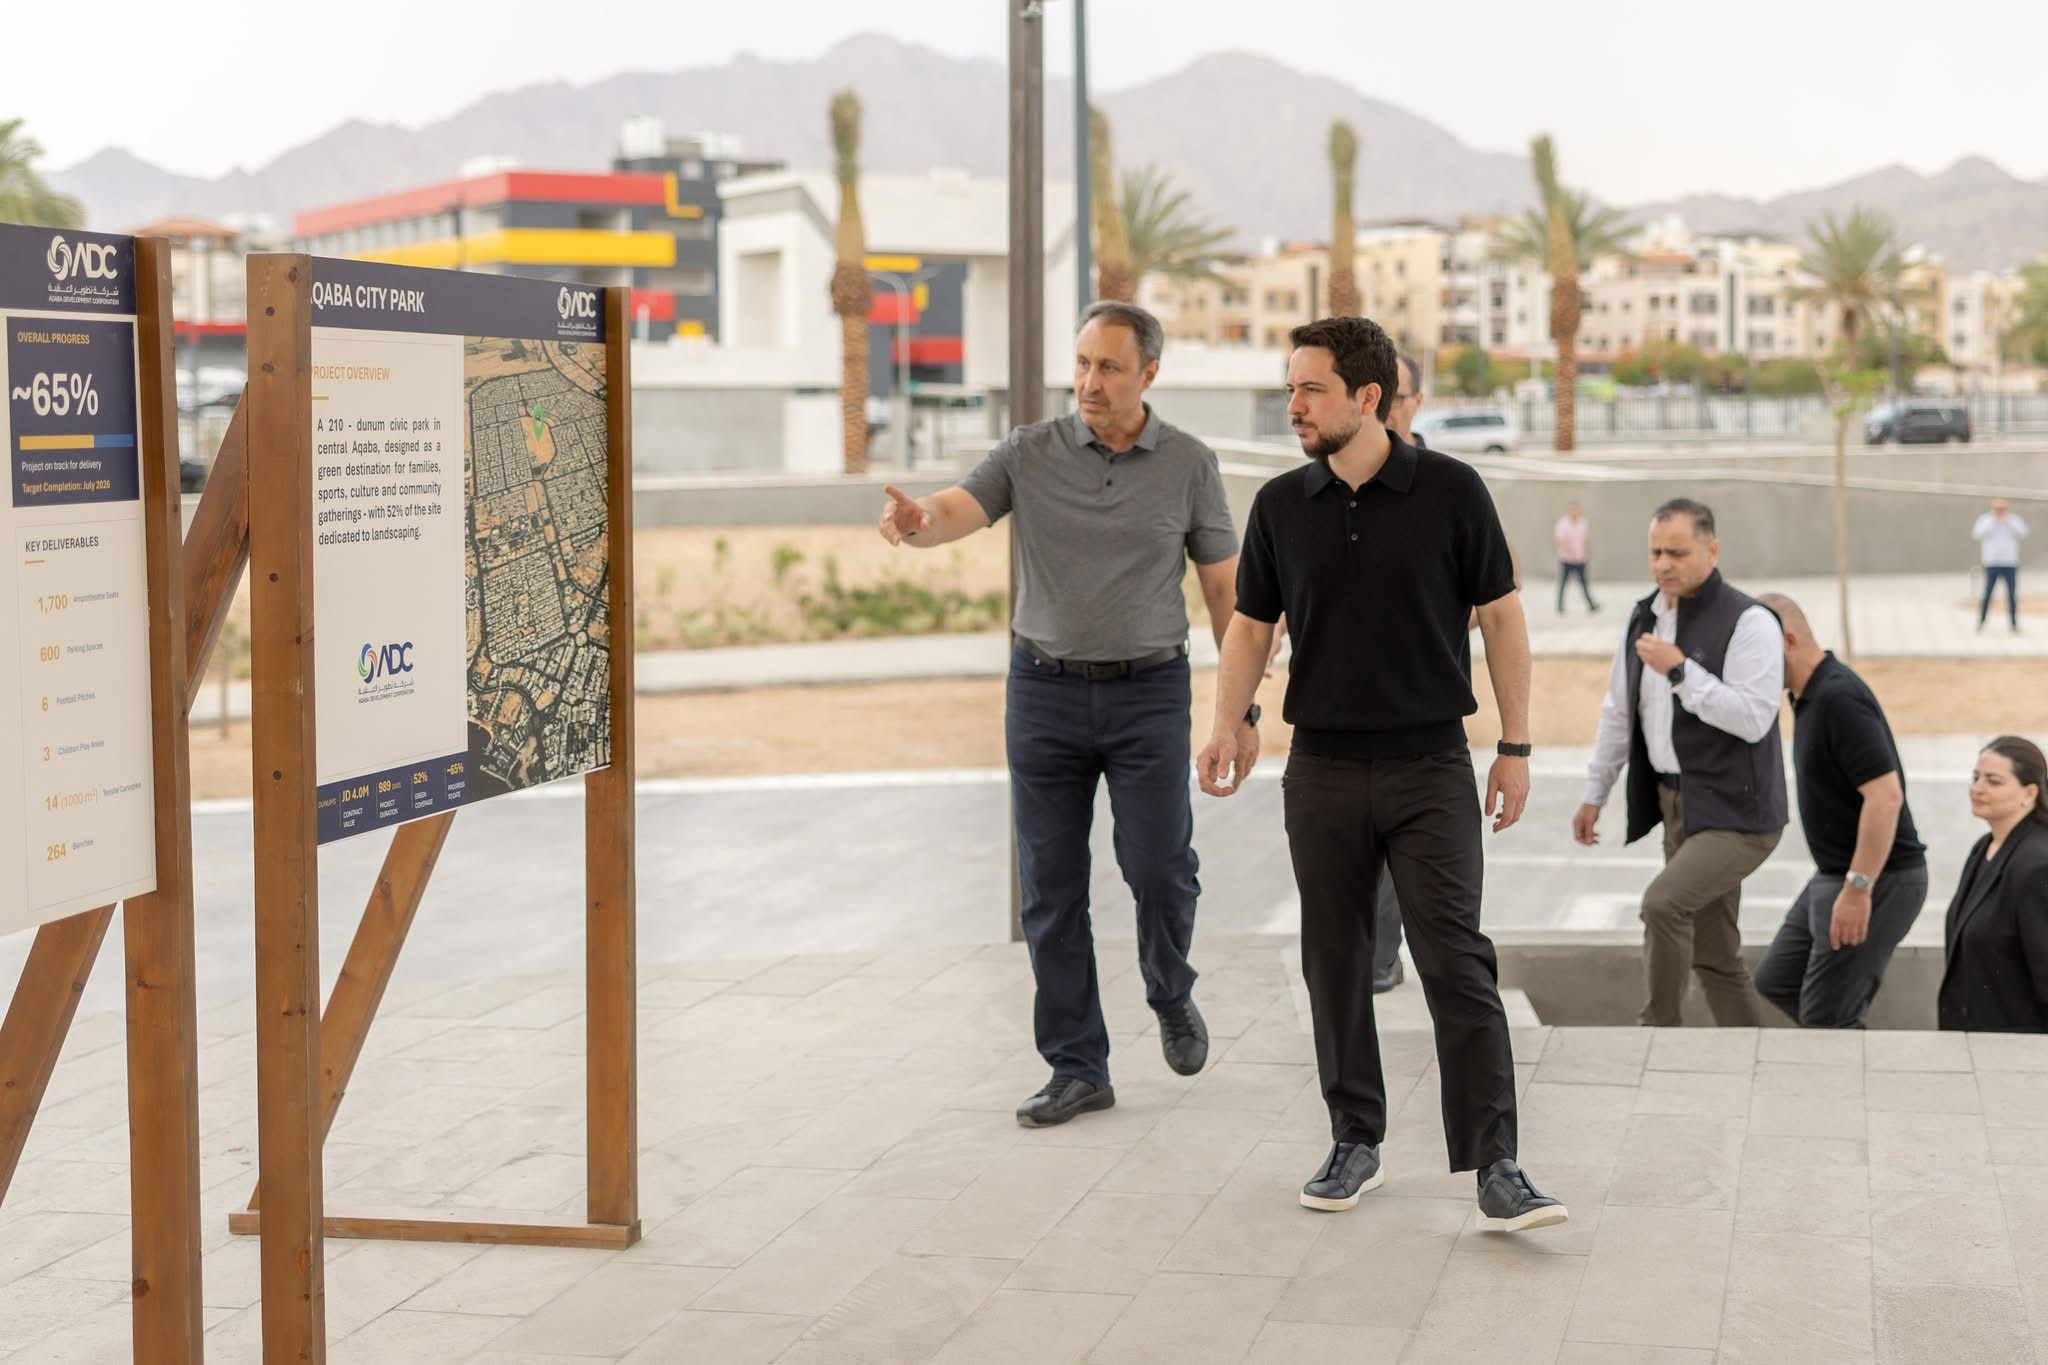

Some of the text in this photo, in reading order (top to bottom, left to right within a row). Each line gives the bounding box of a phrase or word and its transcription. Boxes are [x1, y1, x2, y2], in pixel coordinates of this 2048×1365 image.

[71, 242, 118, 279] ADC
[311, 281, 424, 313] QABA CITY PARK
[570, 290, 596, 318] ADC
[18, 332, 90, 345] OVERALL PROGRESS
[346, 367, 391, 381] OVERVIEW
[12, 372, 99, 416] ~65%
[317, 418, 324, 432] A
[328, 418, 344, 432] 210
[357, 418, 385, 431] dunum
[390, 418, 408, 431] civic
[412, 418, 430, 433] park
[434, 417, 441, 430] in
[317, 440, 441, 456] central Aqaba, designed as a
[21, 460, 102, 473] Project on track for delivery
[317, 460, 441, 480] green destination for families,
[22, 480, 110, 495] Target Completion: July 2026
[318, 481, 442, 502] sports, culture and community
[318, 507, 362, 526] gatherings
[368, 505, 386, 519] with
[387, 504, 403, 518] 52%
[404, 503, 413, 516] of
[414, 503, 426, 516] the
[427, 502, 442, 515] site
[318, 525, 421, 545] dedicated to landscaping.
[25, 536, 99, 552] KEY DELIVERABLES
[38, 594, 68, 614] 1,700
[40, 645, 60, 662] 600
[377, 641, 413, 677] ADC
[42, 696, 49, 712] 6
[43, 746, 50, 762] 3
[413, 771, 428, 784] 52%
[342, 784, 369, 803] JD 4.0M
[378, 780, 392, 793] 989
[46, 793, 58, 811] 14
[379, 799, 395, 808] PROJECT
[343, 807, 363, 818] CONTRACT
[379, 808, 398, 818] DURATION
[343, 819, 356, 828] VALUE
[47, 841, 66, 862] 264
